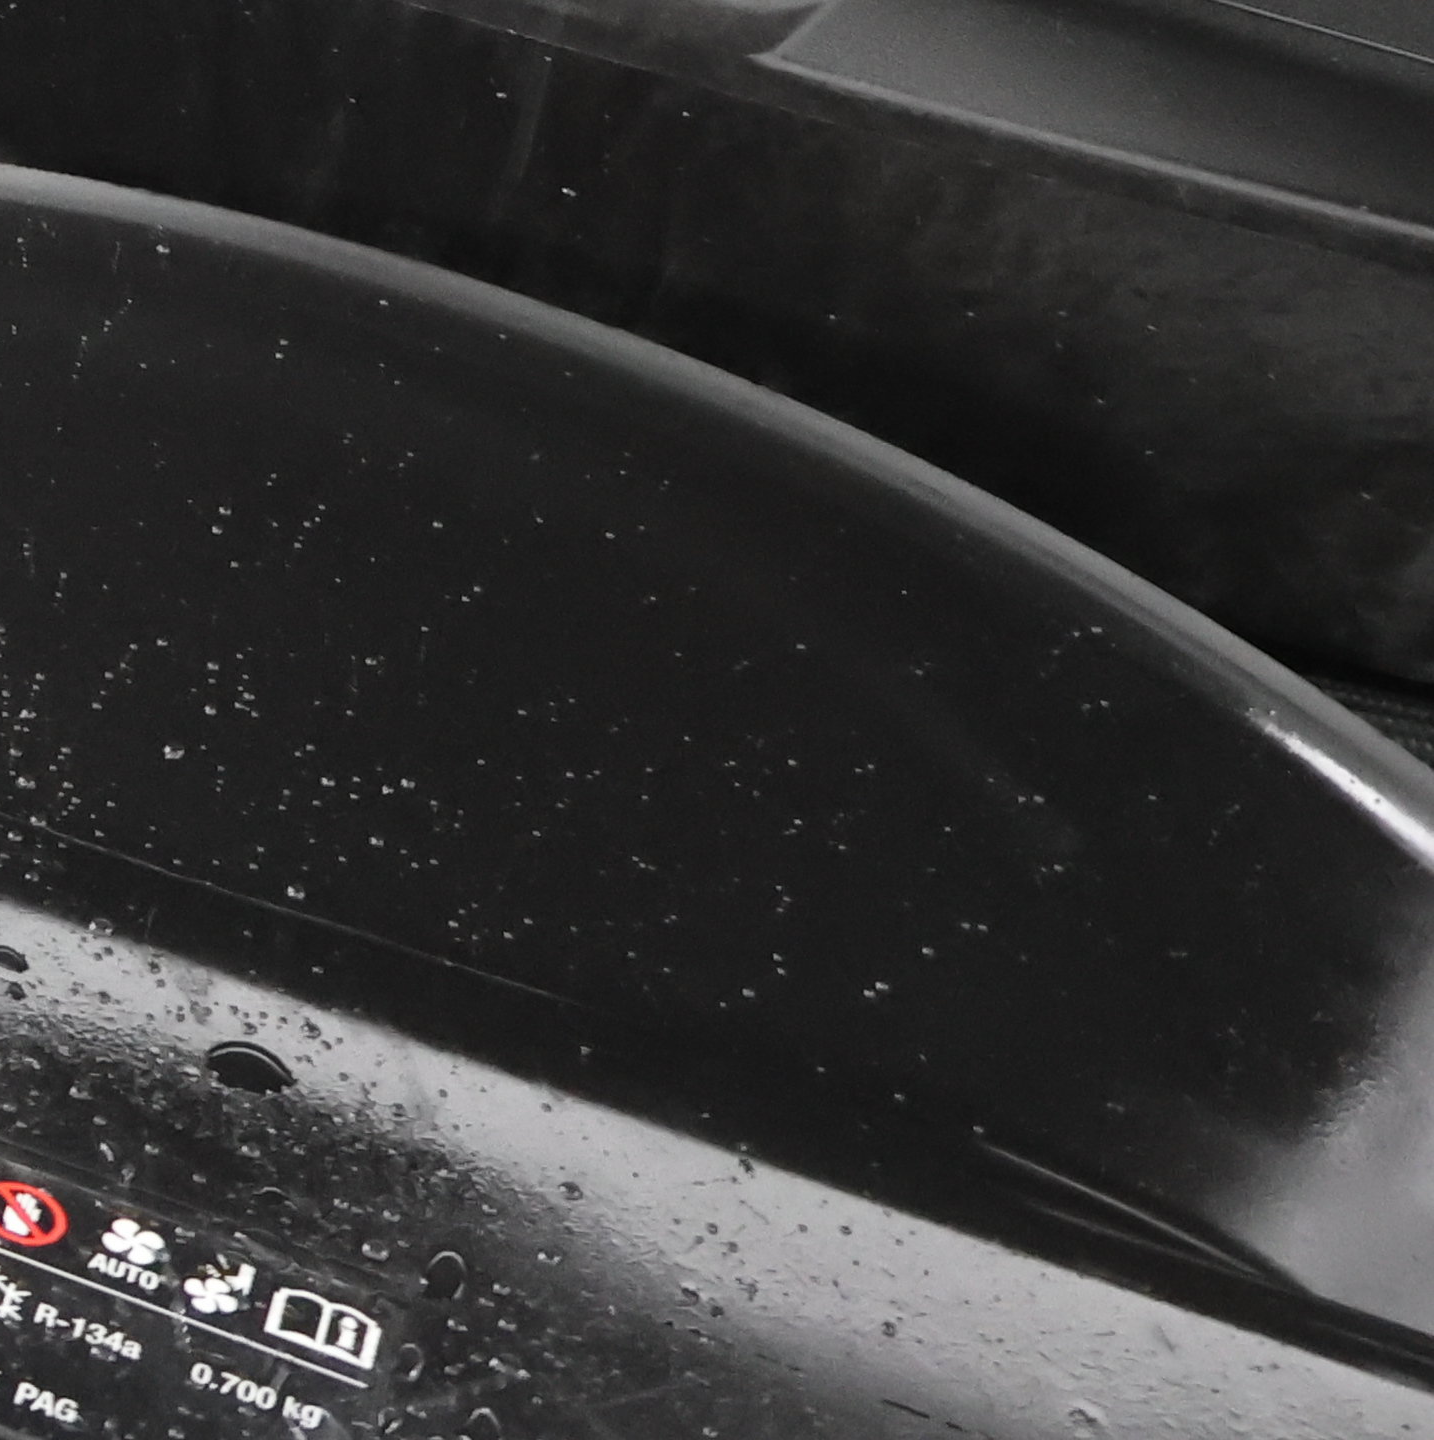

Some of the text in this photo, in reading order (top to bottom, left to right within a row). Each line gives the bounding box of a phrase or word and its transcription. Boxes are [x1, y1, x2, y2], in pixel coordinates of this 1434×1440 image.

[87, 1252, 160, 1291] AUTO
[33, 1302, 323, 1430] R-134a 0.700 kg
[13, 1381, 80, 1423] PAG
